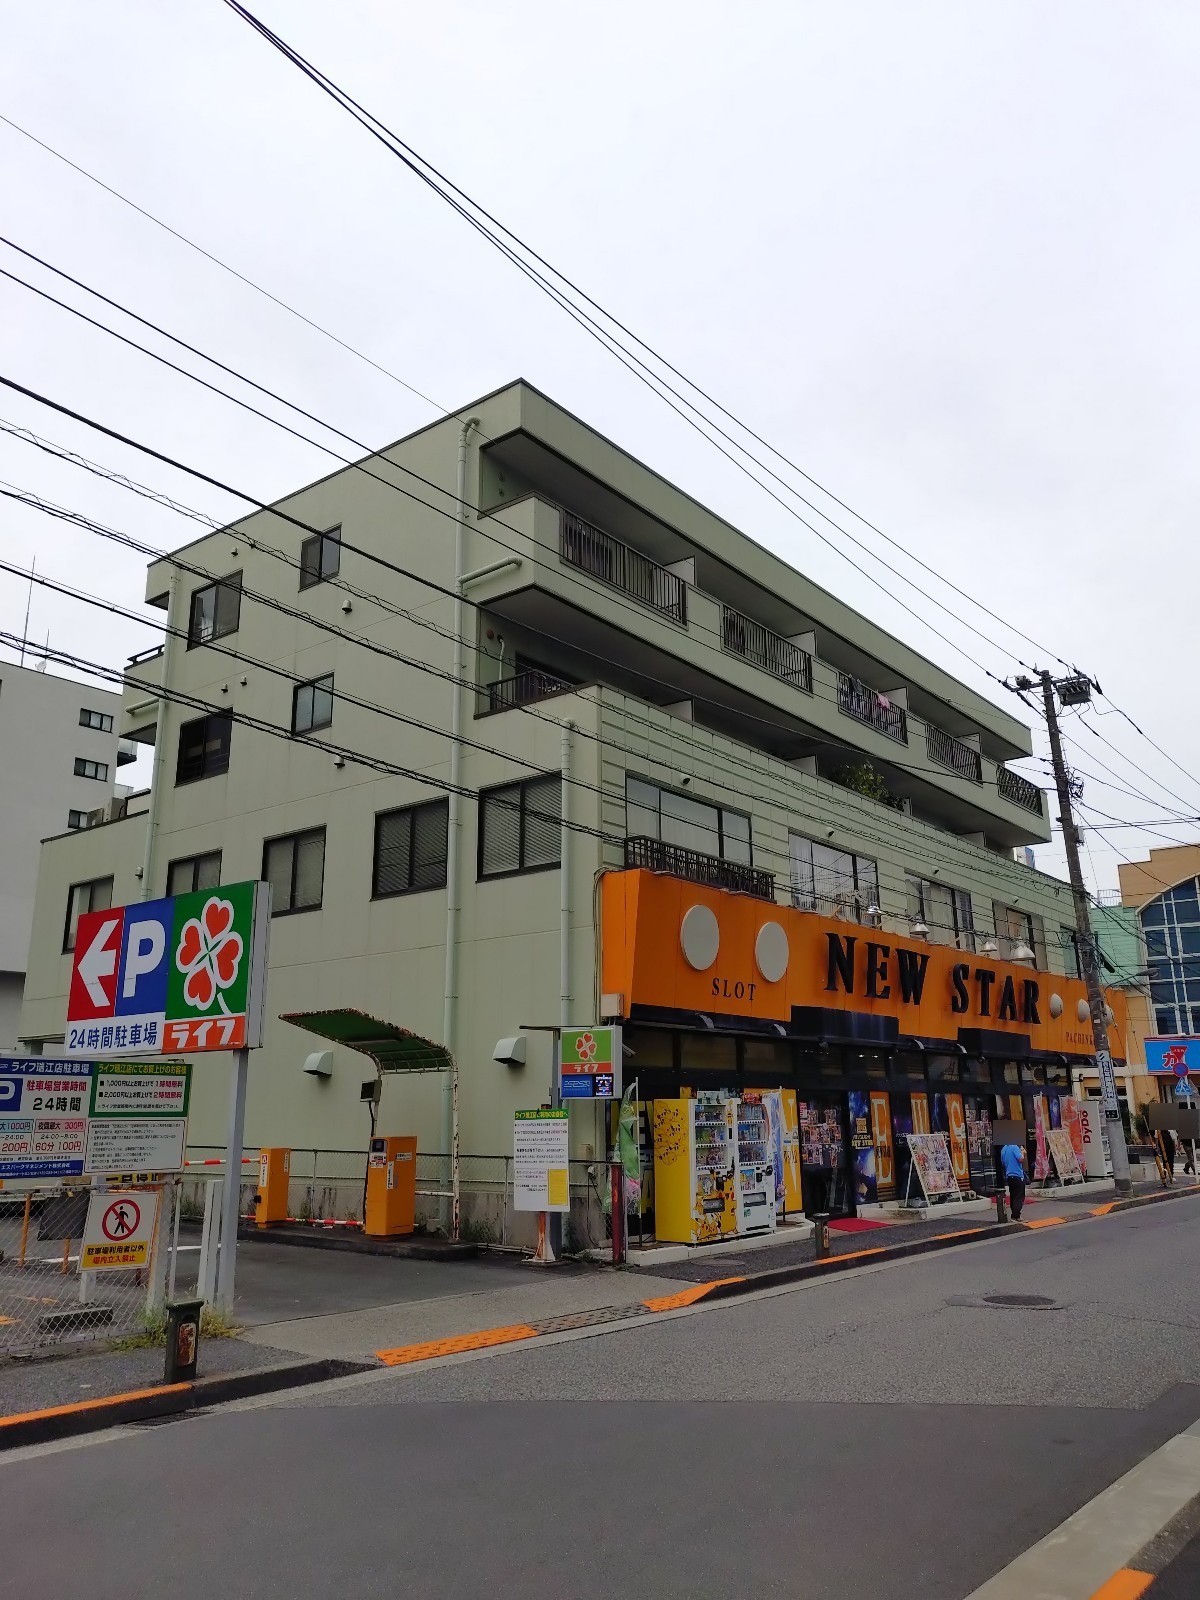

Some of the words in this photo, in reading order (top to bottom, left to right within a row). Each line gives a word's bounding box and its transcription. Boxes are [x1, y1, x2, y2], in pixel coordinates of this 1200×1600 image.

[123, 919, 166, 998] P
[824, 932, 930, 1006] NEW
[952, 963, 1042, 1024] STAR
[711, 977, 756, 1001] SLOT
[69, 1021, 158, 1050] 24時間駐車場
[170, 1019, 236, 1048] ライフ
[1065, 1031, 1093, 1045] PACHINK
[11, 1061, 90, 1075] ライフ瑞江店駐車場
[573, 1064, 598, 1073] ライフ
[26, 1080, 87, 1092] 駐車場営業時間
[33, 1097, 82, 1112] 24時間
[1081, 1110, 1092, 1143] DyDo
[35, 1142, 55, 1152] 60分
[59, 1141, 82, 1151] 100円
[87, 1244, 145, 1255] 駐車場利用者以外
